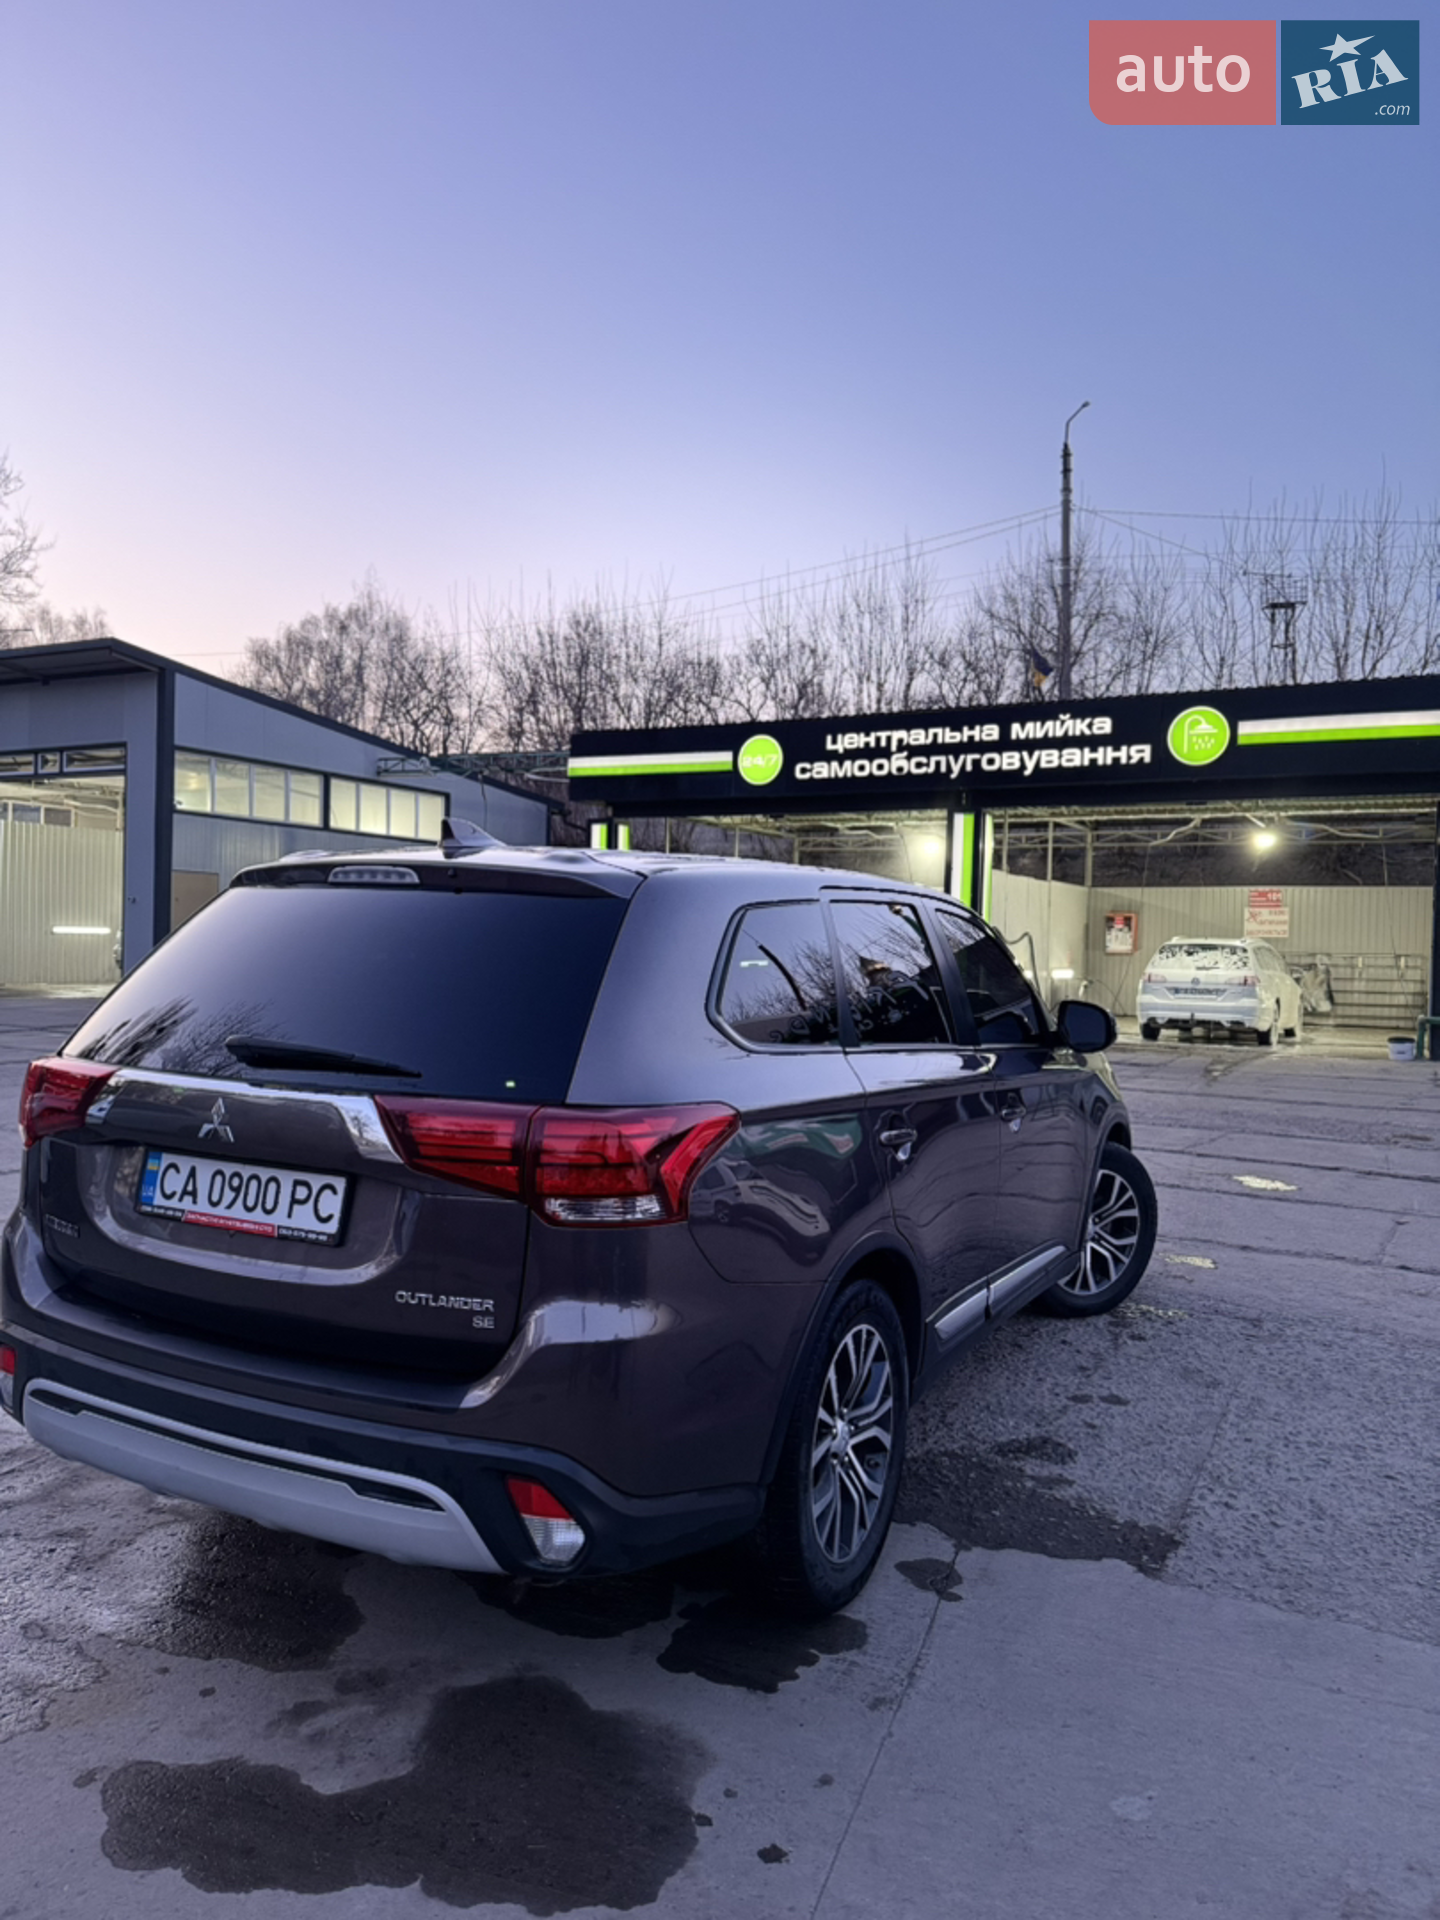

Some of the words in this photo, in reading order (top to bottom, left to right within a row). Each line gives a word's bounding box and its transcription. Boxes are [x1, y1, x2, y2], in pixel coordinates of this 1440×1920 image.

[825, 723, 1000, 754] центральна
[1011, 713, 1112, 740] мийка
[741, 754, 779, 769] 24/7
[794, 744, 1152, 780] самообслуговування
[159, 1162, 199, 1206] CA
[207, 1168, 281, 1216] 0900
[287, 1178, 338, 1224] PC
[394, 1290, 495, 1313] OUTLANDER
[472, 1315, 495, 1329] SE
